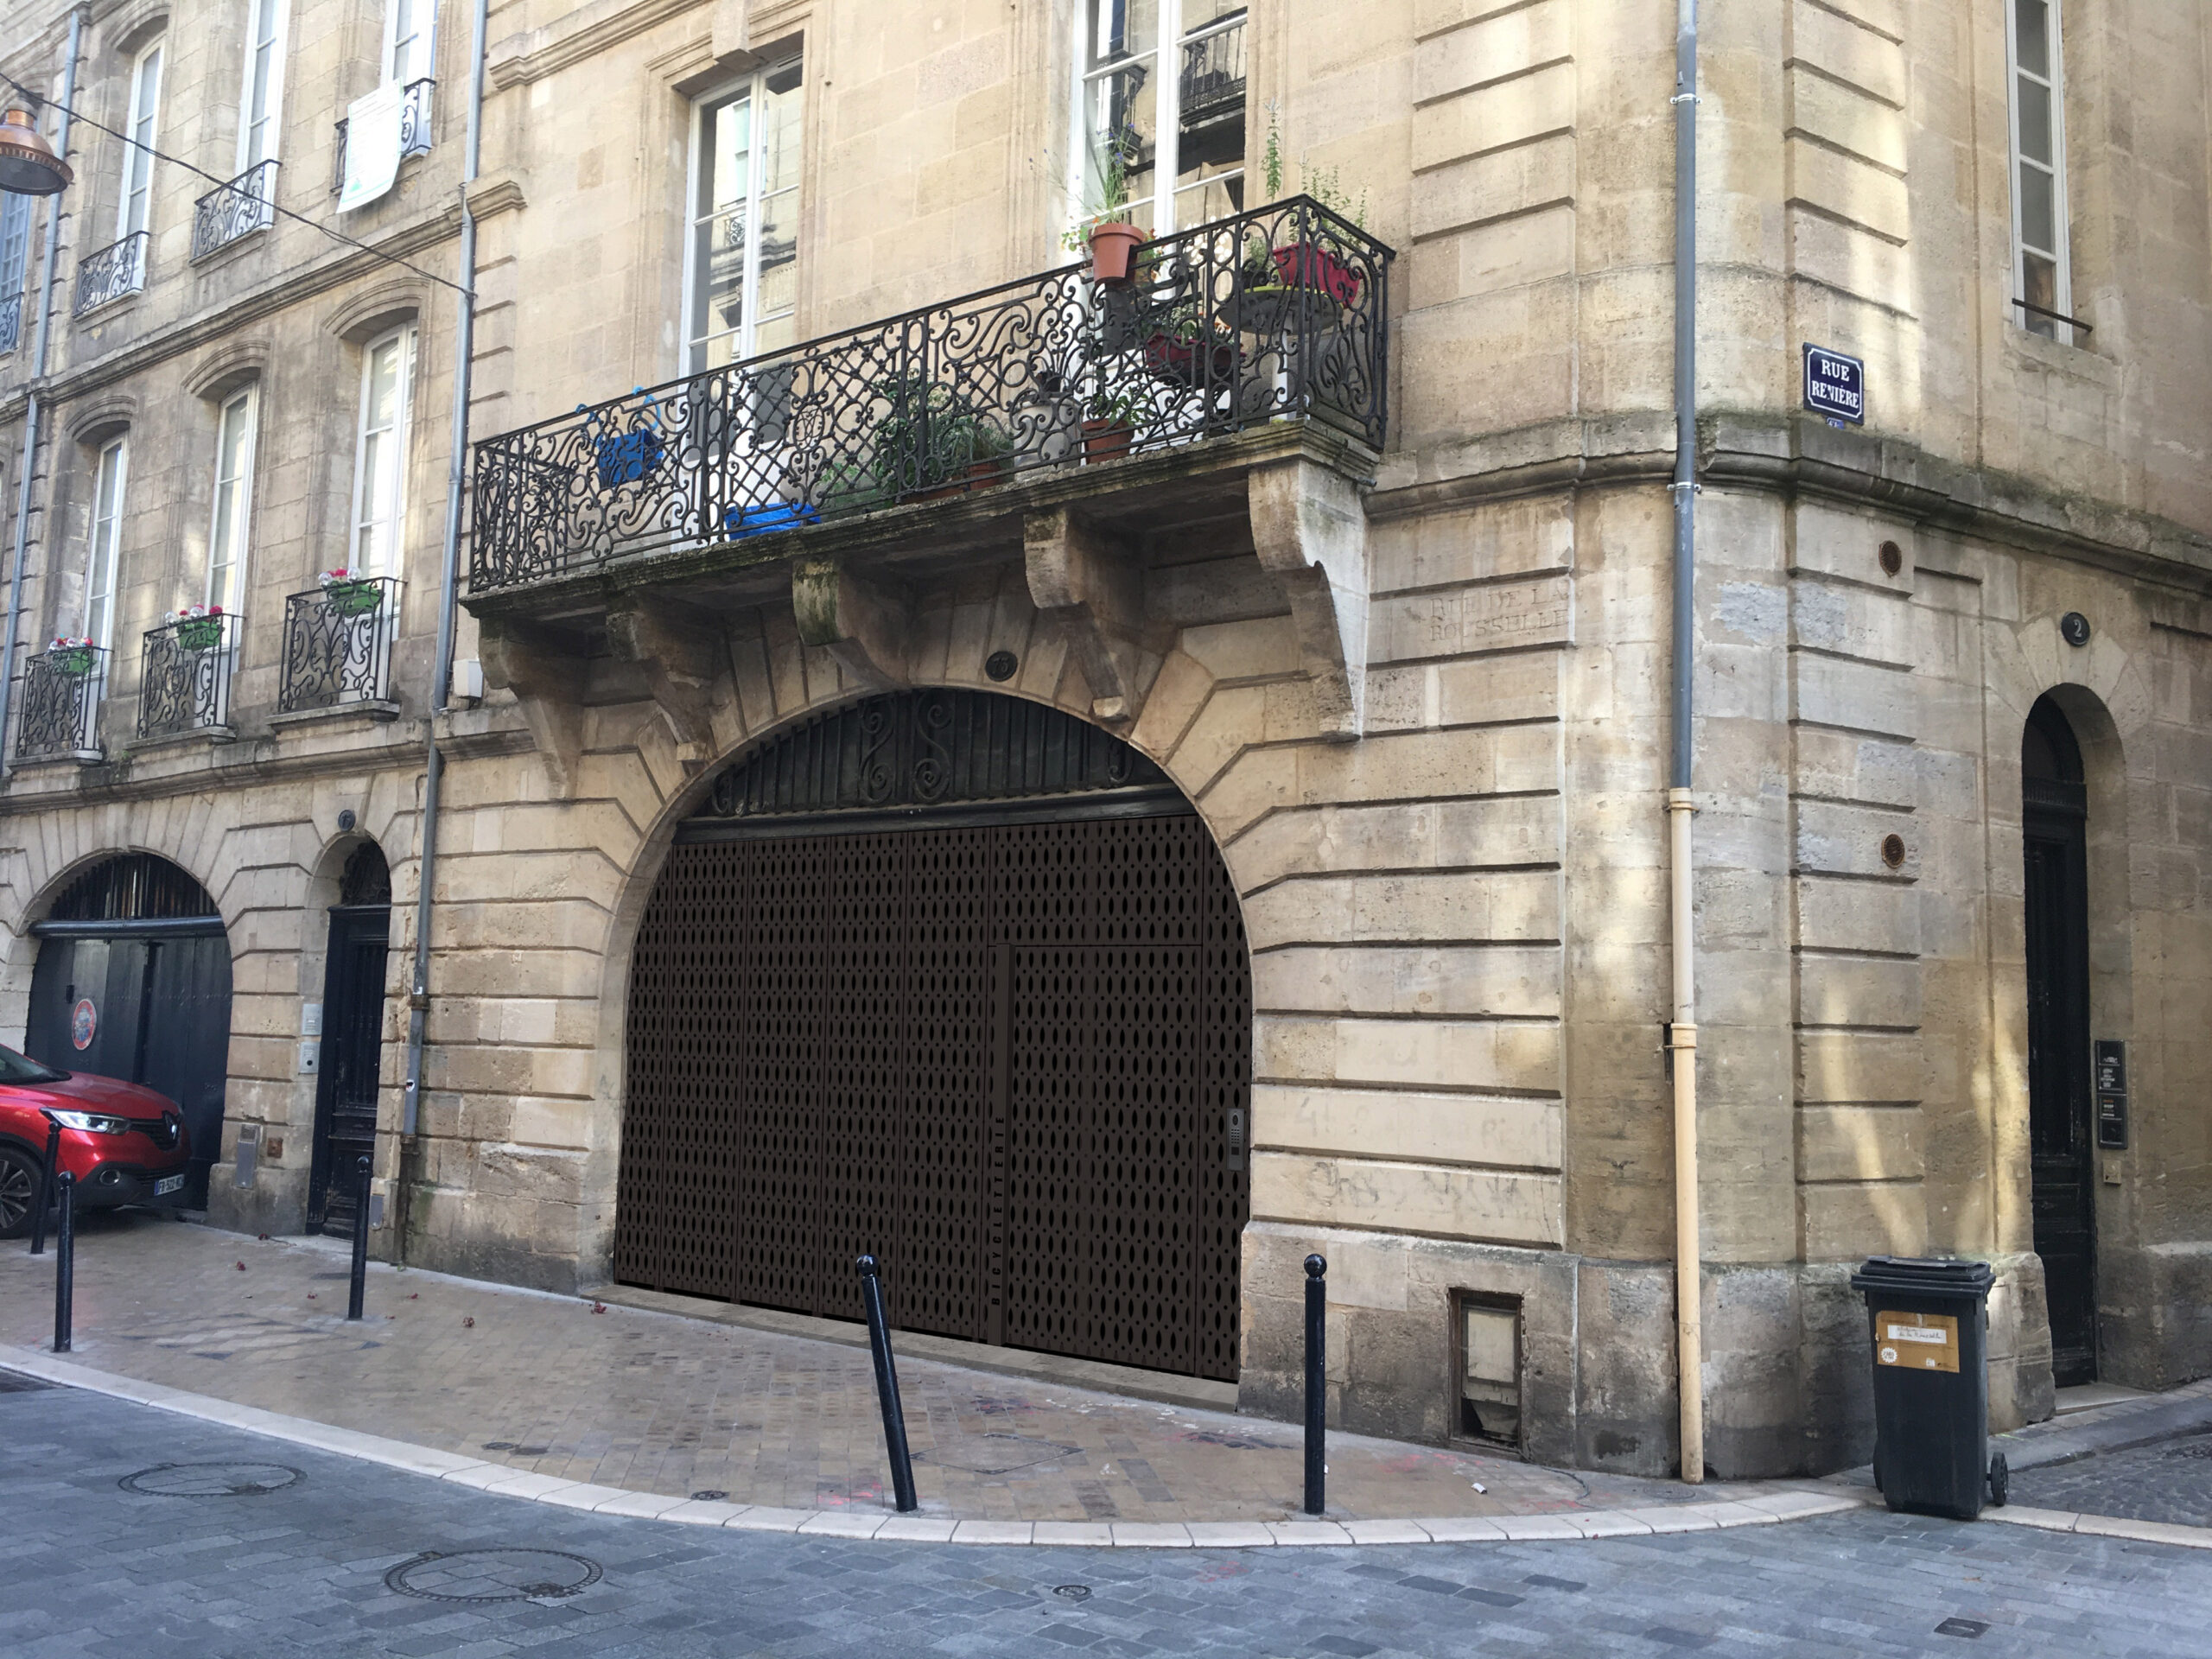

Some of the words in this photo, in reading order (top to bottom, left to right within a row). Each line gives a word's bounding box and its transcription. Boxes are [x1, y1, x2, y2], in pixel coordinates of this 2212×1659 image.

[1821, 359, 1850, 382] RUE
[1487, 589, 1522, 609] DE
[2074, 619, 2082, 638] 2
